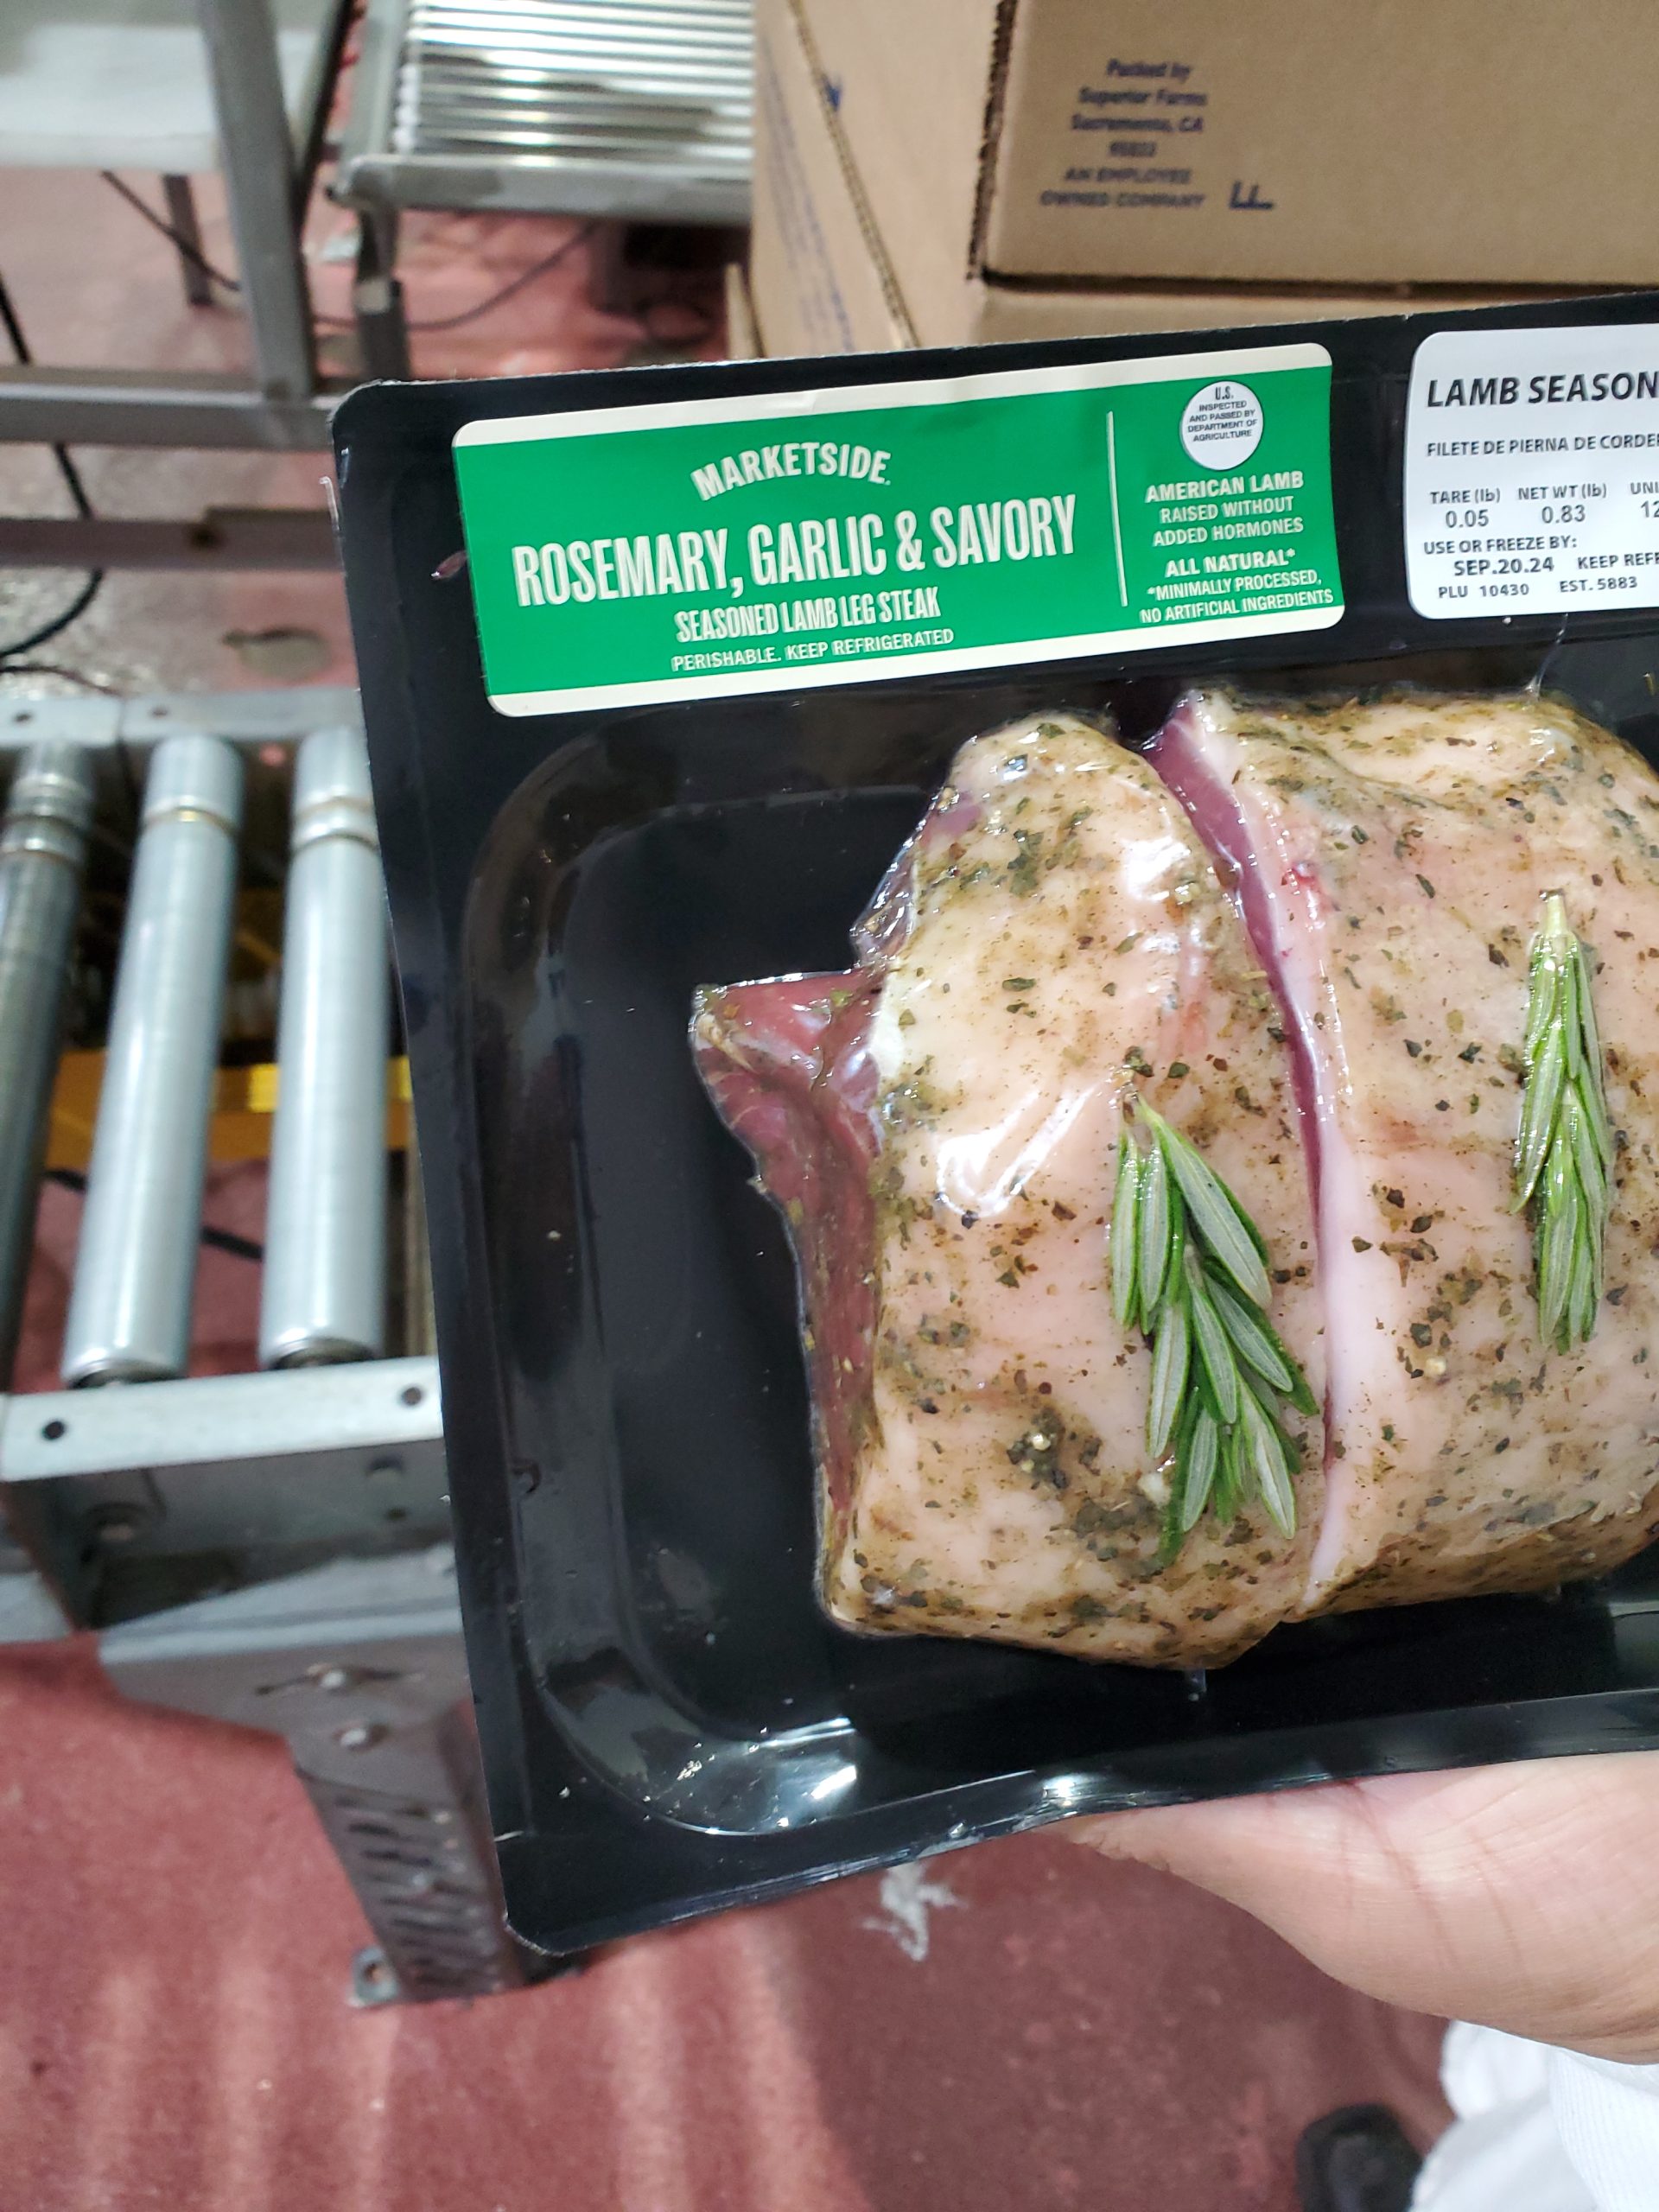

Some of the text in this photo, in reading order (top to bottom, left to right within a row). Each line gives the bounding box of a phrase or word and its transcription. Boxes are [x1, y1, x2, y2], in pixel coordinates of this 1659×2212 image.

[1215, 385, 1234, 401] U.S.
[1427, 377, 1521, 408] LAMB
[1189, 409, 1256, 423] AND PASSED BY
[1198, 400, 1248, 412] INSPECTED
[1187, 418, 1258, 433] DEPARTMENT OF
[1192, 429, 1253, 442] AGRICULTURE
[1427, 441, 1480, 456] FILETE
[1484, 439, 1505, 454] DE
[1510, 436, 1569, 454] PIERNA
[1574, 435, 1597, 450] DE
[1145, 470, 1305, 504] AMERICAN LAMB
[1430, 490, 1471, 505] TARE
[1474, 487, 1502, 504] (lb)
[1518, 486, 1548, 500] NET
[1553, 485, 1579, 499] WT
[1582, 482, 1608, 499] (lb)
[1160, 496, 1294, 524] RAISED WITHOUT
[1446, 508, 1490, 529] 0.05
[1541, 505, 1586, 524] 0.83
[1152, 517, 1305, 547] ADDED HORMONES
[512, 493, 1077, 607] ROSEMARY, GARLIC & SAVORY
[1424, 534, 1578, 556] USE OR FREEZE BY:
[1165, 556, 1201, 578] ALL
[1453, 556, 1554, 577] SEP.20.24
[1577, 554, 1619, 570] KEEP
[1236, 569, 1322, 592] PROCESSED,
[1438, 582, 1529, 599] PLU 10430
[1560, 575, 1638, 594] EST. 5883
[674, 586, 941, 644] SEASONED LAMB LEG STEAK
[1140, 588, 1334, 624] NO ARTIFICIAL INGREDIENTS
[671, 627, 955, 673] PERISHABLE. KEEP REFRIGERATED
